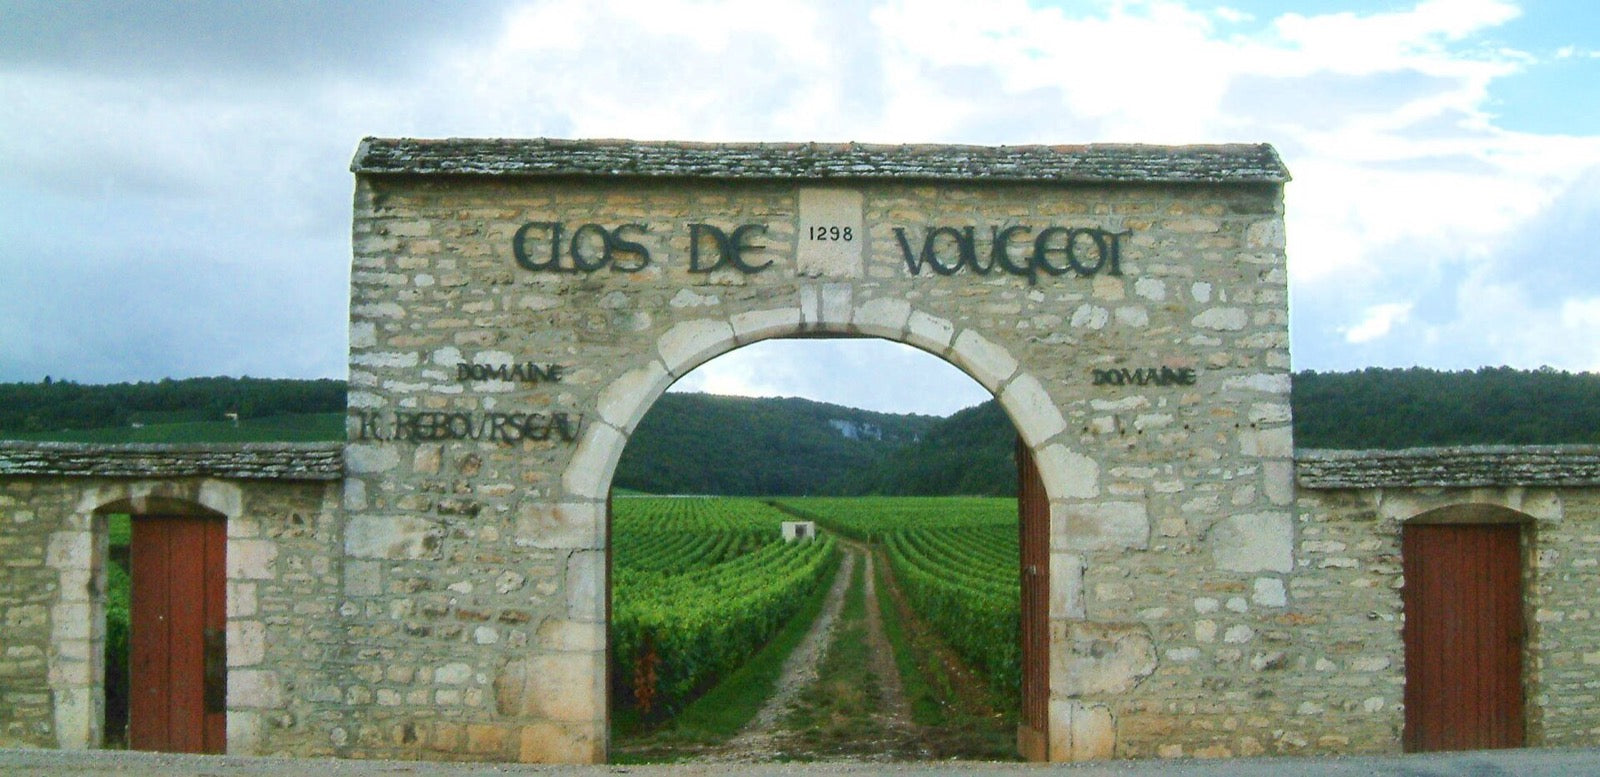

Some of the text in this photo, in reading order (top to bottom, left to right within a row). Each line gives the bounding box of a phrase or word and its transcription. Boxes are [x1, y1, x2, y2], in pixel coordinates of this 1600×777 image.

[512, 221, 1133, 285] CLOS DE VOUGEOT
[808, 226, 853, 241] 1298
